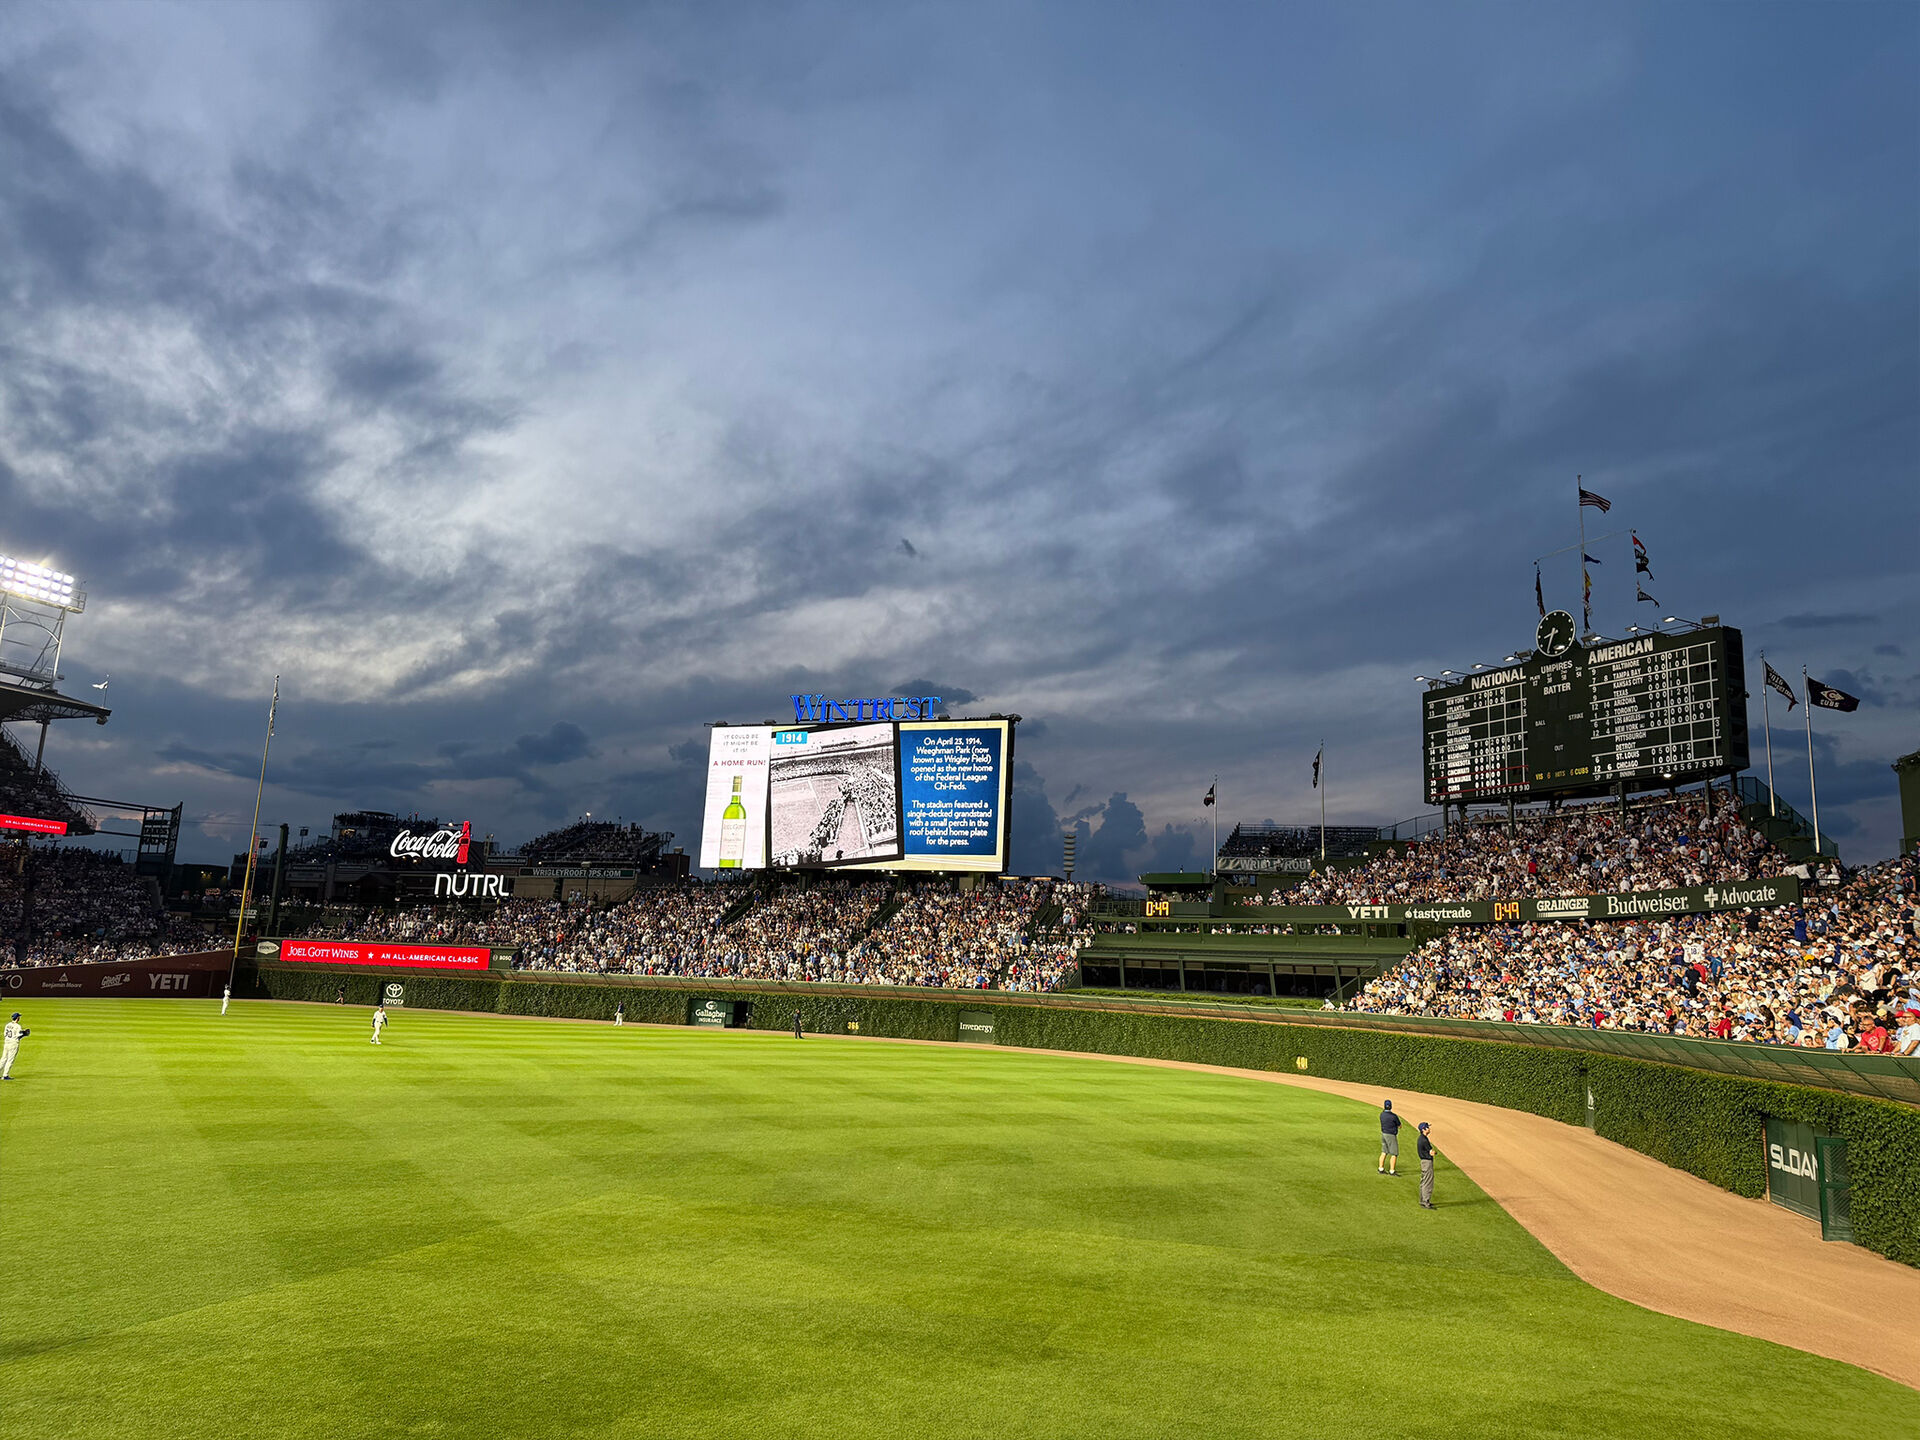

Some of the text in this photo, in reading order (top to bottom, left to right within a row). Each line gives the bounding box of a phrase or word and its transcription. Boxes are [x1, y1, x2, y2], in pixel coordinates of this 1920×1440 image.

[1588, 637, 1654, 665] AMERICAN
[1540, 660, 1573, 675] UMPIRES
[1612, 659, 1640, 672] BALTIMORE
[1471, 667, 1527, 690] NATIONAL
[1613, 667, 1642, 680] TAMPA BAY
[1613, 677, 1644, 689] KANSAS CITY
[1543, 682, 1571, 696] BATTER
[1613, 688, 1629, 698] TEXAS
[1614, 696, 1636, 707] ARIZONA
[789, 694, 942, 723] WINTRUST
[1614, 705, 1639, 715] TORONTO
[1614, 716, 1622, 724] LOS
[1615, 725, 1625, 733] NEW
[1625, 723, 1638, 732] YORK
[781, 733, 803, 743] 1914
[923, 737, 936, 746] On
[936, 737, 953, 747] April
[965, 737, 982, 745] 1914,
[1615, 731, 1647, 743] PITTSBURGH
[916, 745, 989, 756] Weeghman Park (now
[1616, 741, 1636, 751] DETROIT
[912, 755, 935, 764] known
[943, 754, 970, 765] Wrigley
[971, 754, 992, 764] Field)
[1624, 750, 1640, 760] LOUIS
[910, 764, 936, 774] opened
[945, 763, 957, 772] the
[973, 763, 993, 772] home
[1616, 760, 1639, 770] CHICAGO
[1574, 767, 1589, 775] CUBS
[915, 772, 988, 783] of the Federal League
[934, 782, 967, 790] Chi-Feds.
[1448, 785, 1460, 793] CUBS
[911, 799, 925, 809] The
[926, 799, 953, 809] stadium
[954, 799, 983, 809] featured
[907, 808, 993, 819] single-decked grandstand
[909, 818, 924, 827] with
[930, 818, 948, 827] small
[948, 818, 968, 828] perch
[969, 819, 976, 827] in
[977, 818, 989, 827] the
[909, 827, 988, 838] roof behind home plate
[926, 836, 970, 847] for the press.
[1721, 884, 1777, 905] Advocate
[1146, 901, 1169, 917] 0:49
[1537, 898, 1589, 911] GRAINGER
[1606, 895, 1688, 916] Budweiser
[1346, 906, 1389, 919] YETI
[1412, 906, 1472, 922] tastytrade
[1494, 902, 1519, 921] 0:49
[287, 944, 359, 959] JOEL GOTT WINES
[392, 953, 446, 962] ALL-AMERICAN
[447, 955, 479, 964] CLASSIC
[149, 974, 191, 990] YETI
[959, 1022, 994, 1033] Invenergy
